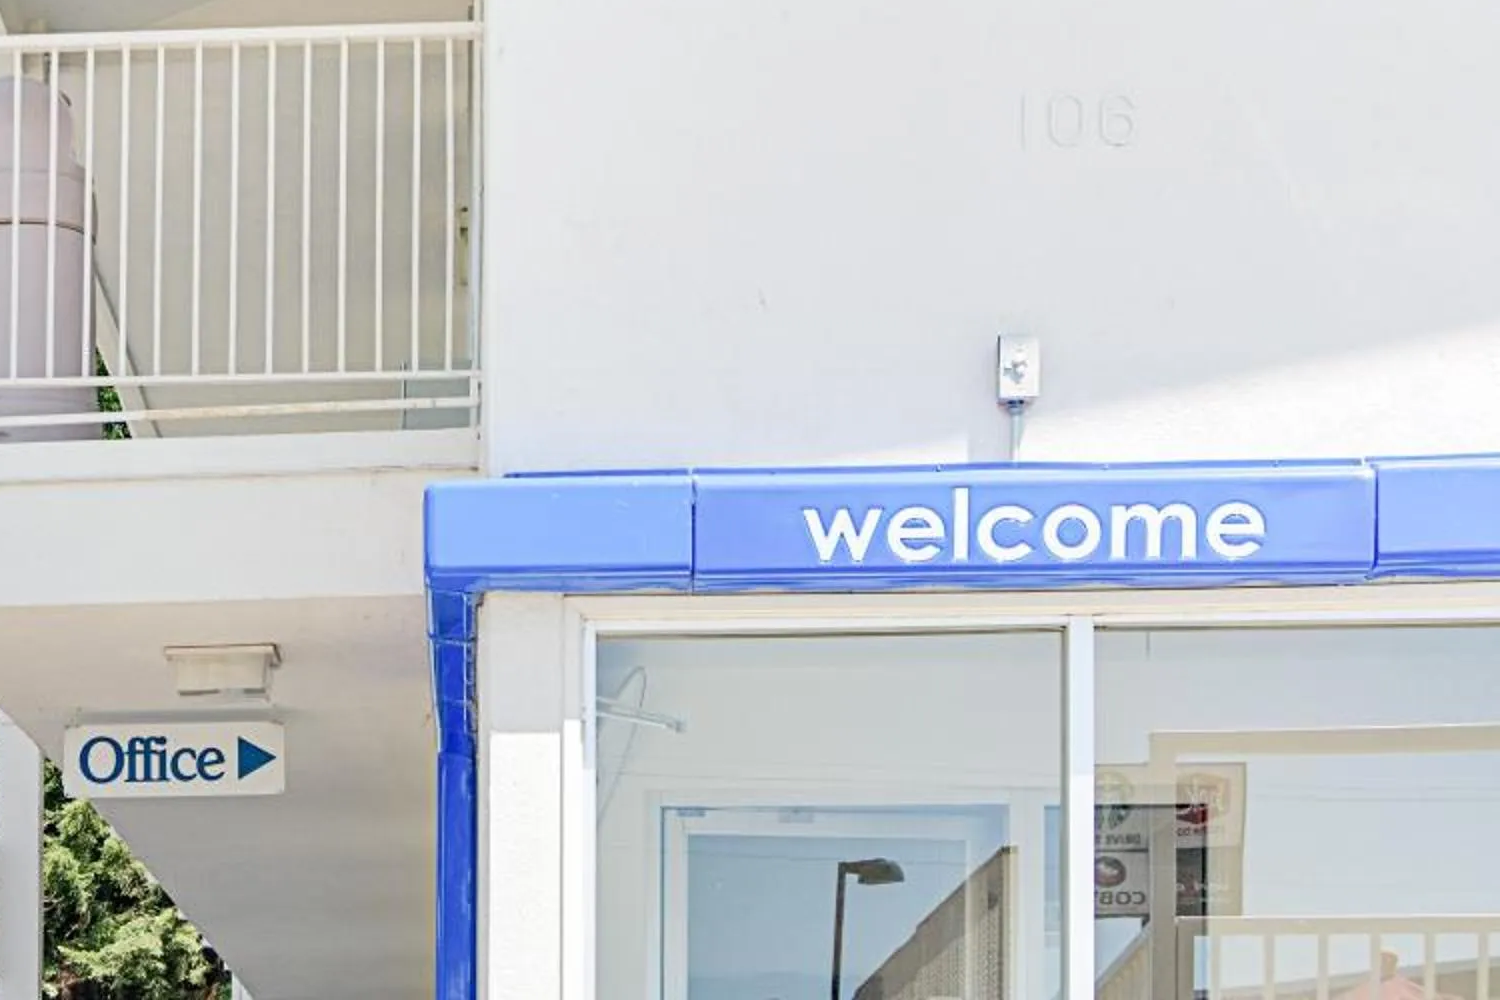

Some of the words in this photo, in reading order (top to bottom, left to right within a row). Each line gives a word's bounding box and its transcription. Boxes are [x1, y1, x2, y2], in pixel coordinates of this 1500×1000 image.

[1019, 92, 1135, 150] 106
[802, 486, 1267, 564] welcome
[79, 735, 226, 784] Office
